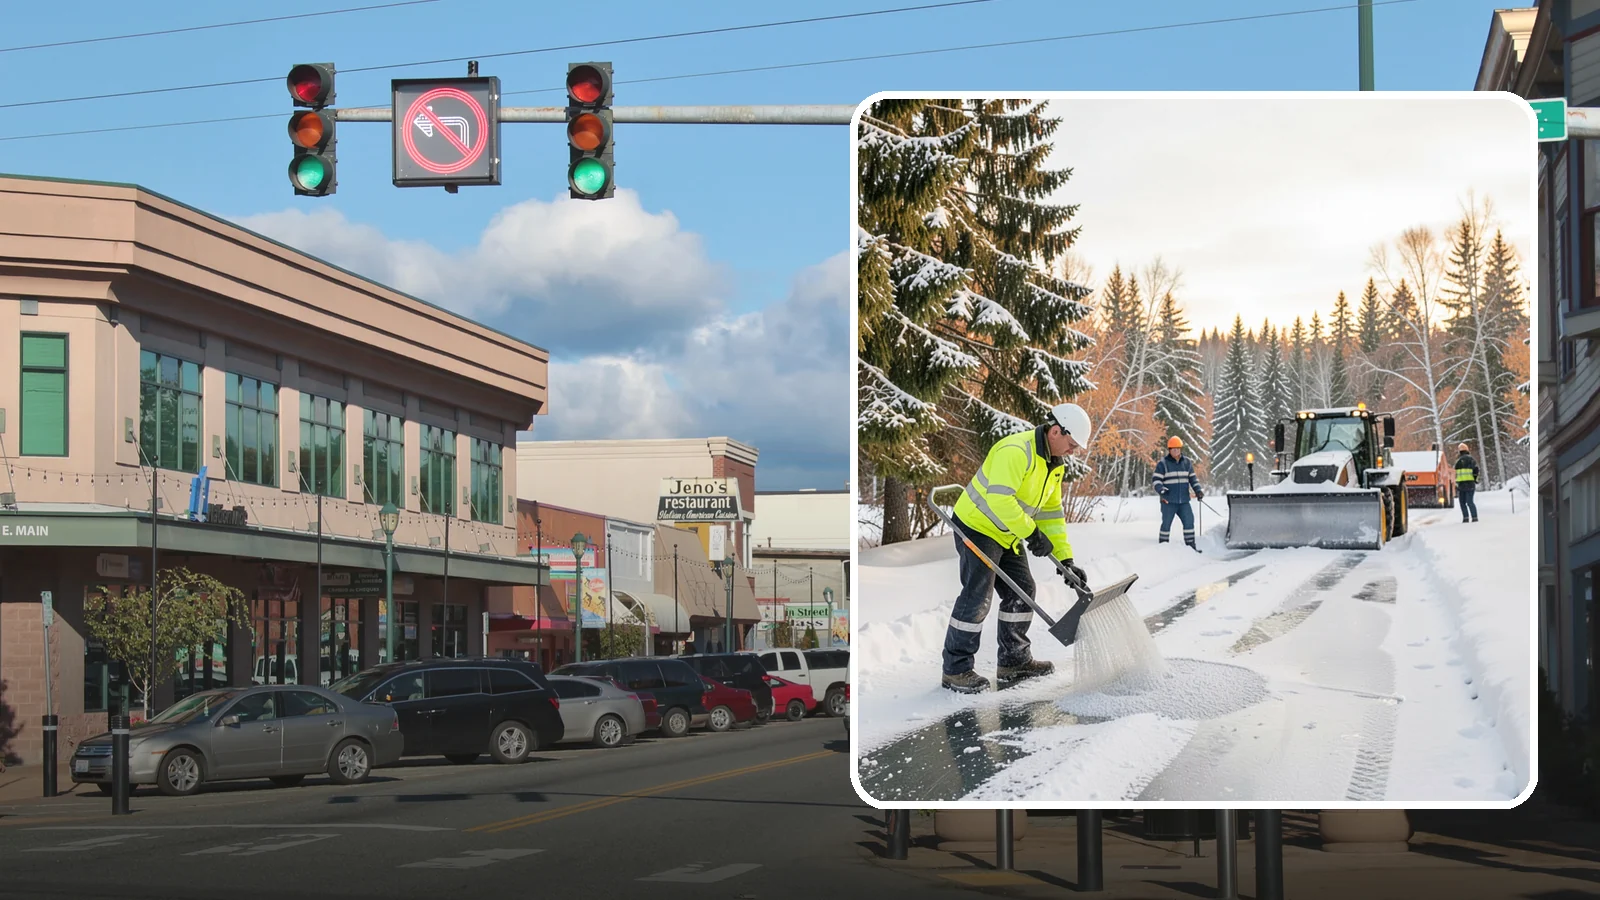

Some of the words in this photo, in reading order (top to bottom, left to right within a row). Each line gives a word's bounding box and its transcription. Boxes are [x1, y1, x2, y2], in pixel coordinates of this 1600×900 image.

[670, 480, 727, 494] Jeno's
[665, 496, 731, 509] restaurant
[658, 510, 681, 519] Italian
[686, 509, 714, 519] American
[715, 509, 737, 519] Cuisine
[2, 525, 13, 536] E.
[15, 525, 49, 536] MAIN
[797, 607, 829, 617] Street
